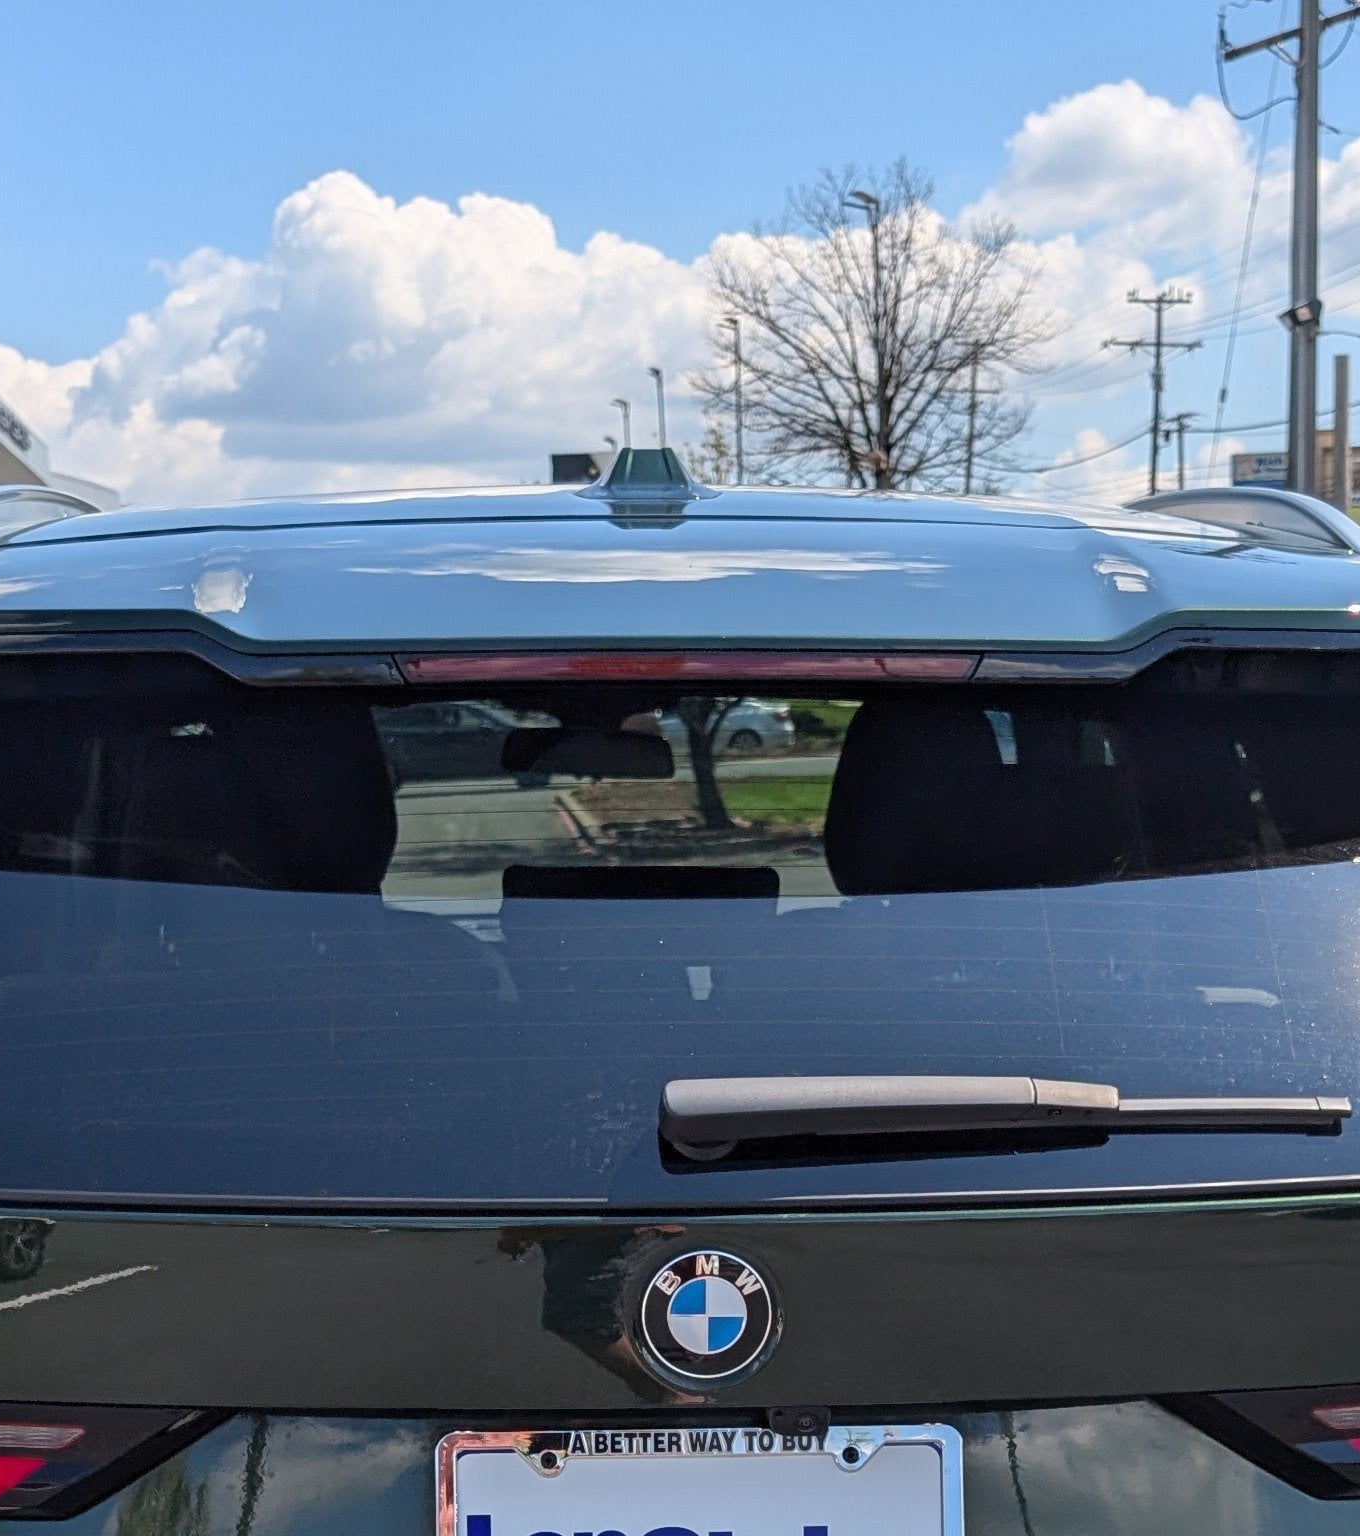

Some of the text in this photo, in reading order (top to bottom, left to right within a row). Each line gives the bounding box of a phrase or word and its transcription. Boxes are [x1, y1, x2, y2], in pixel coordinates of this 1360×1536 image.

[655, 1254, 762, 1296] BMW
[570, 1433, 588, 1454] A
[594, 1432, 682, 1454] BETTER
[689, 1431, 736, 1453] WAY
[743, 1430, 774, 1452] TO
